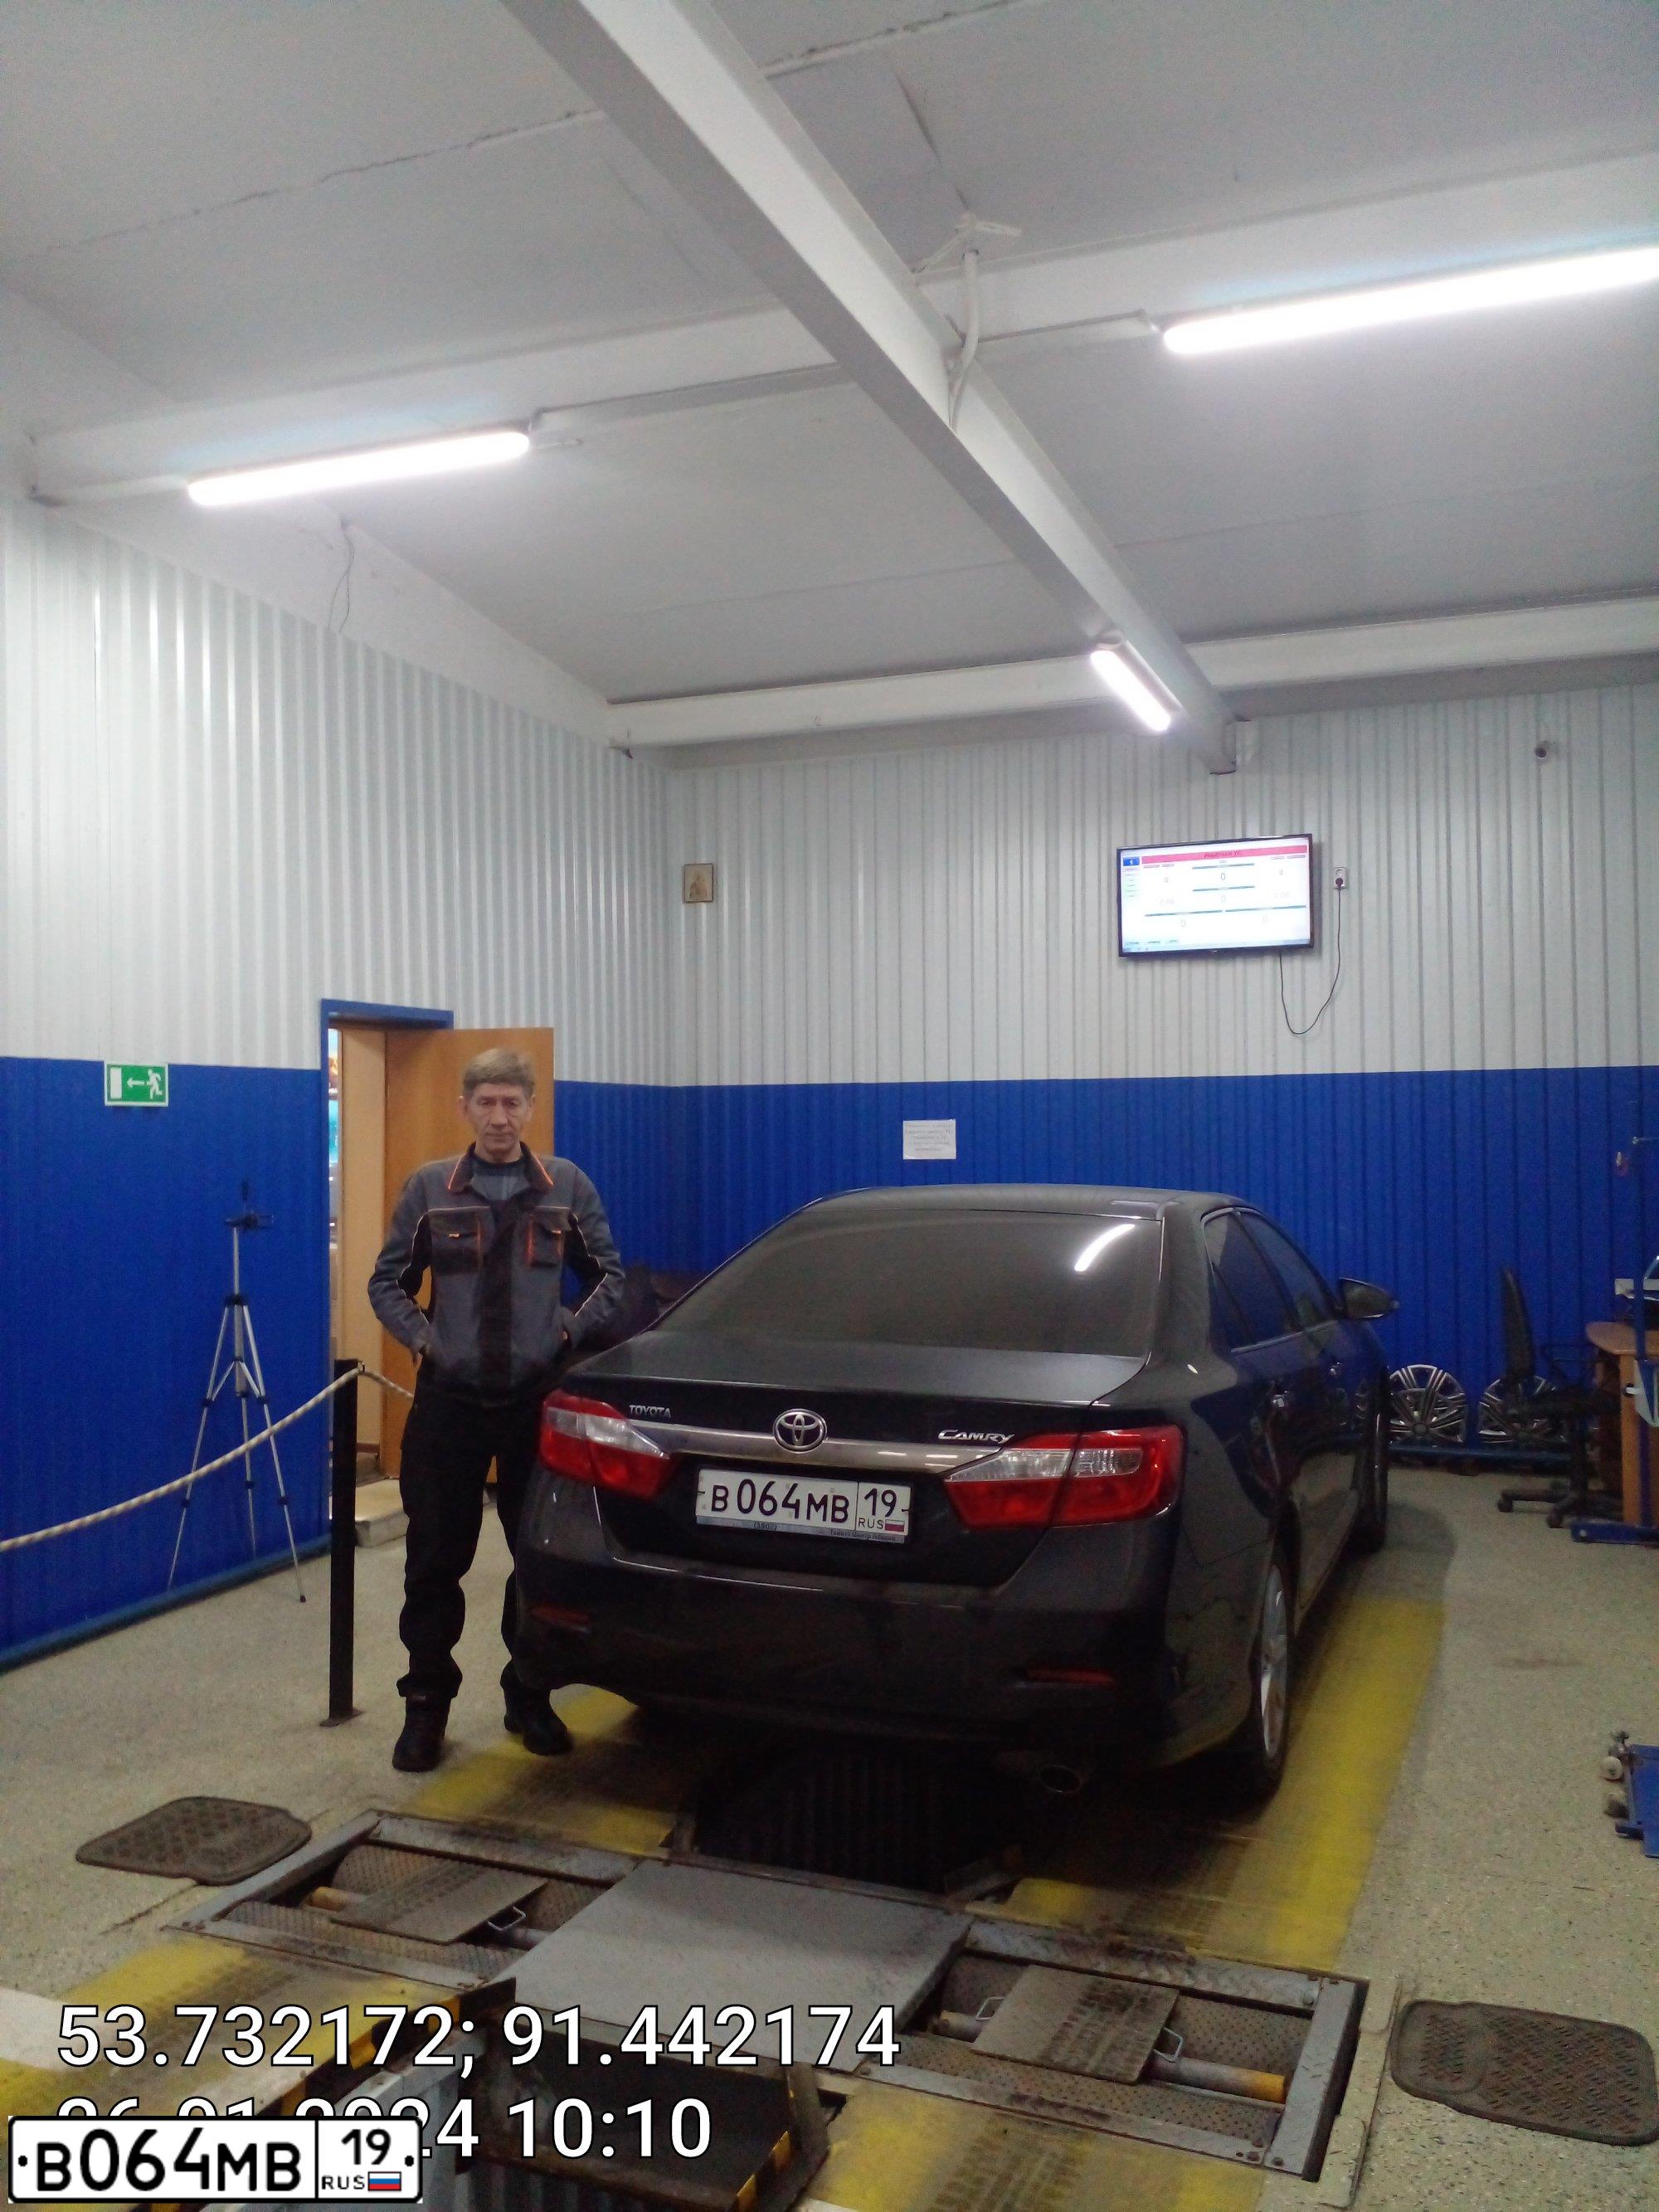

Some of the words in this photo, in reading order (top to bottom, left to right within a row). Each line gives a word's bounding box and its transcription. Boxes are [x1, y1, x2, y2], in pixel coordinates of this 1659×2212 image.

[1220, 872, 1226, 880] 0
[629, 1404, 672, 1418] TOYOTA
[937, 1429, 1015, 1445] CAMRY
[864, 1488, 898, 1518] 19
[857, 1517, 885, 1529] RUS
